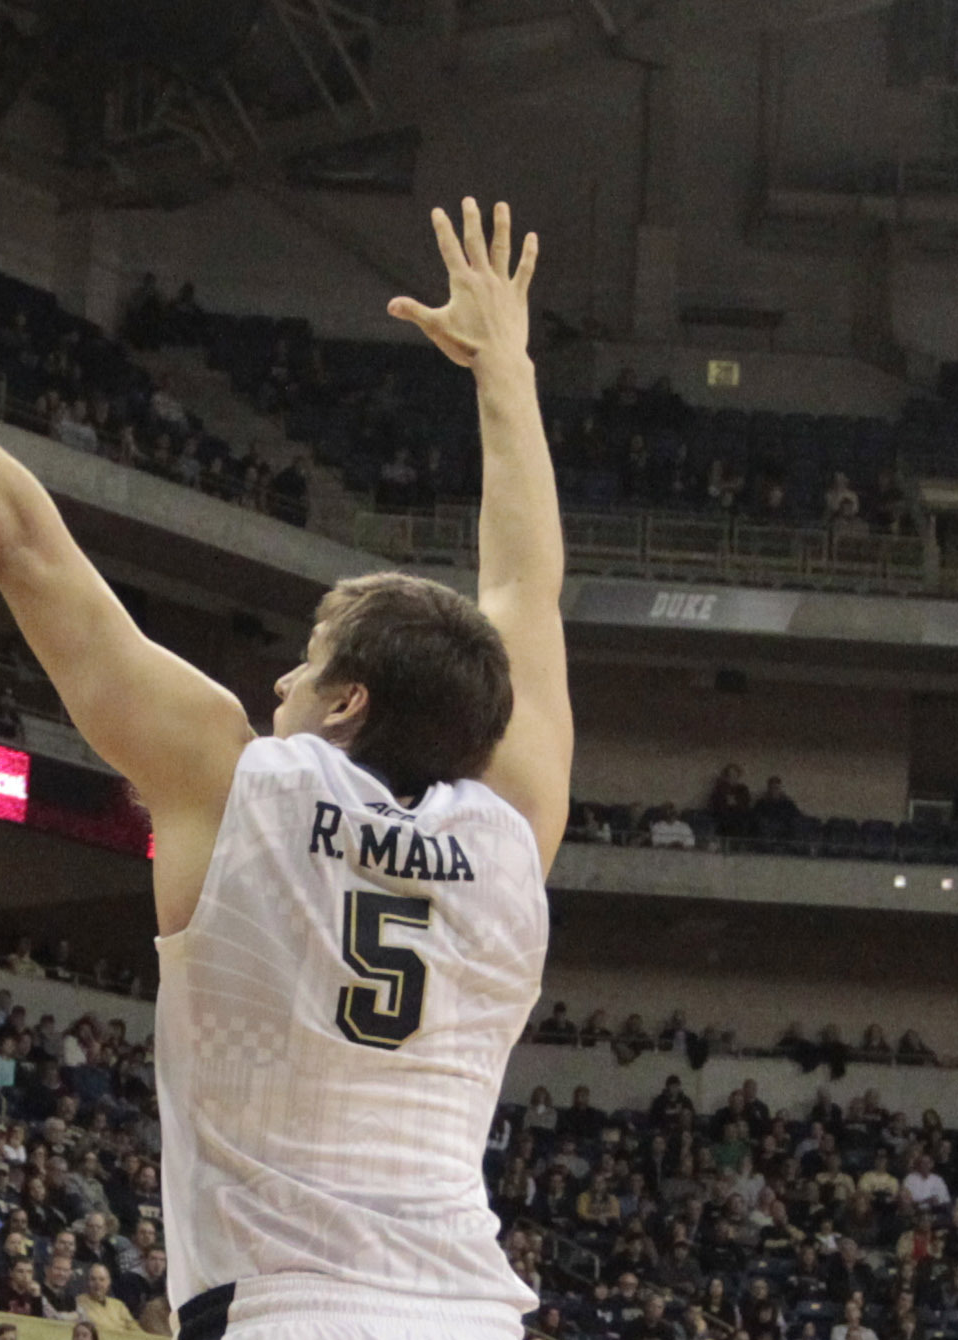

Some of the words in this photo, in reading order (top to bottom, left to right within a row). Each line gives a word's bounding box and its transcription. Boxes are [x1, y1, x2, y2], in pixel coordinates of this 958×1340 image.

[650, 592, 718, 620] DUKE
[309, 801, 344, 860] R.
[359, 824, 475, 881] MAIA
[335, 890, 433, 1052] 5
